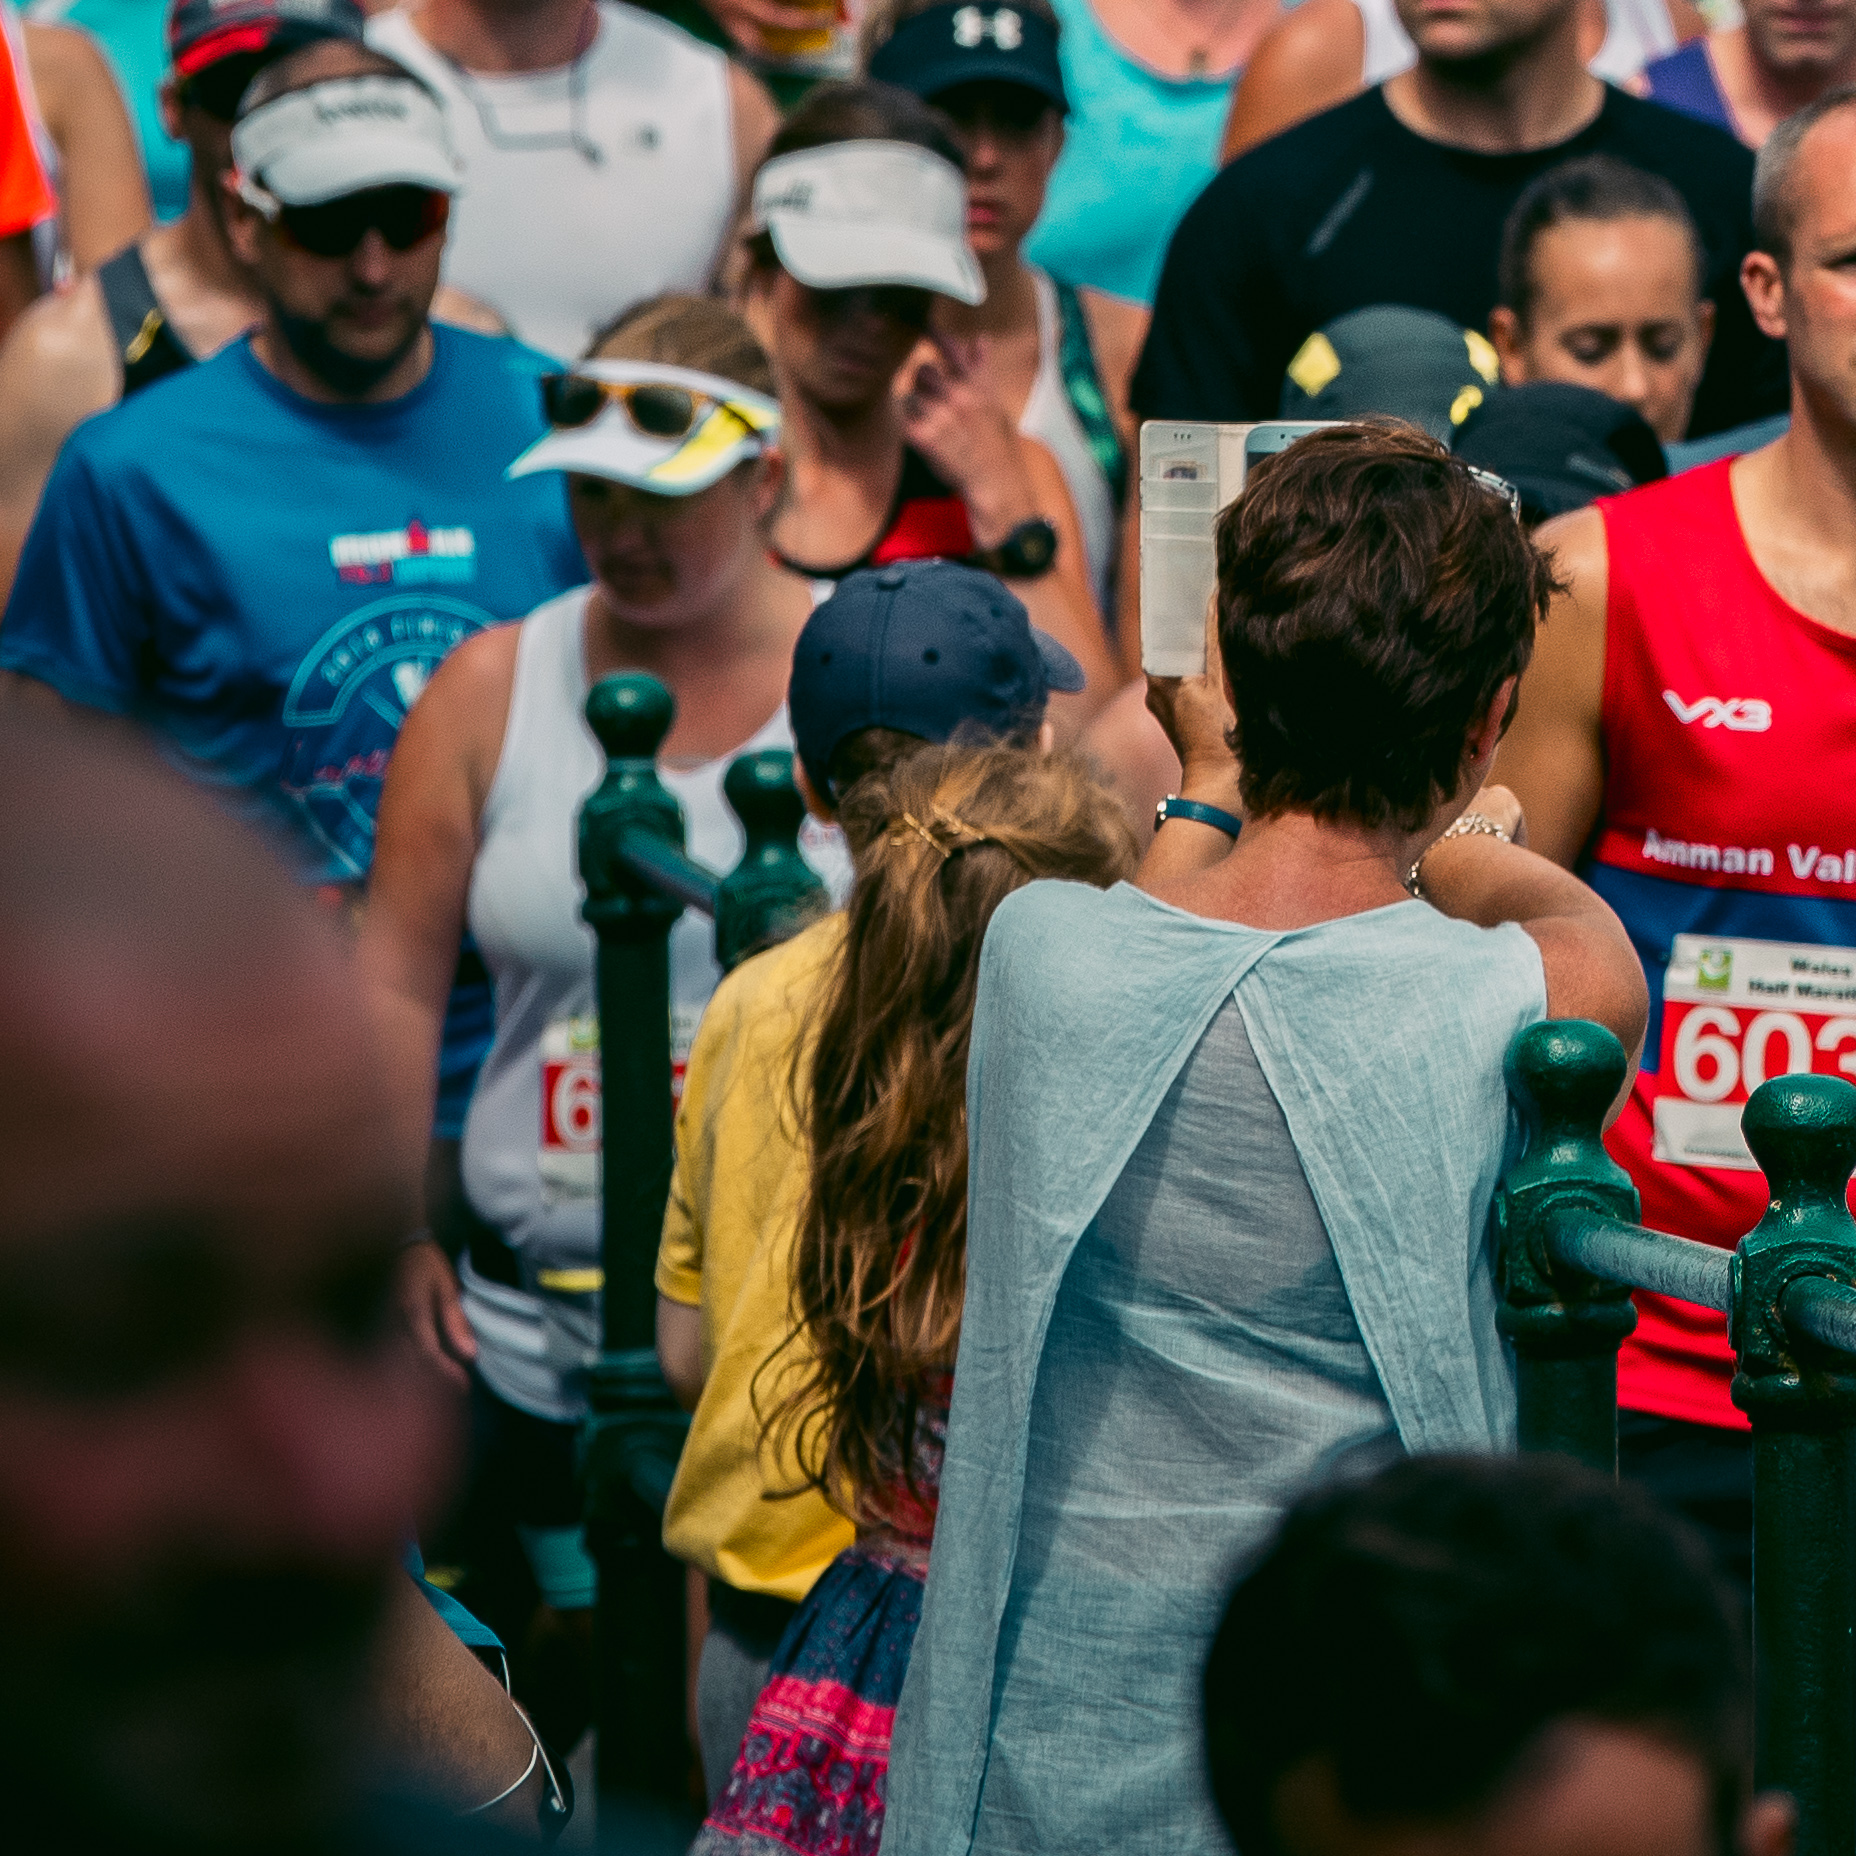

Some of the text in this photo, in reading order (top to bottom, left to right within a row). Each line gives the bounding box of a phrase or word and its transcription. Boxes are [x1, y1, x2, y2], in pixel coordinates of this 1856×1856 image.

[1642, 828, 1774, 876] Amman
[1791, 956, 1852, 977] Wales
[1749, 979, 1789, 996] Half
